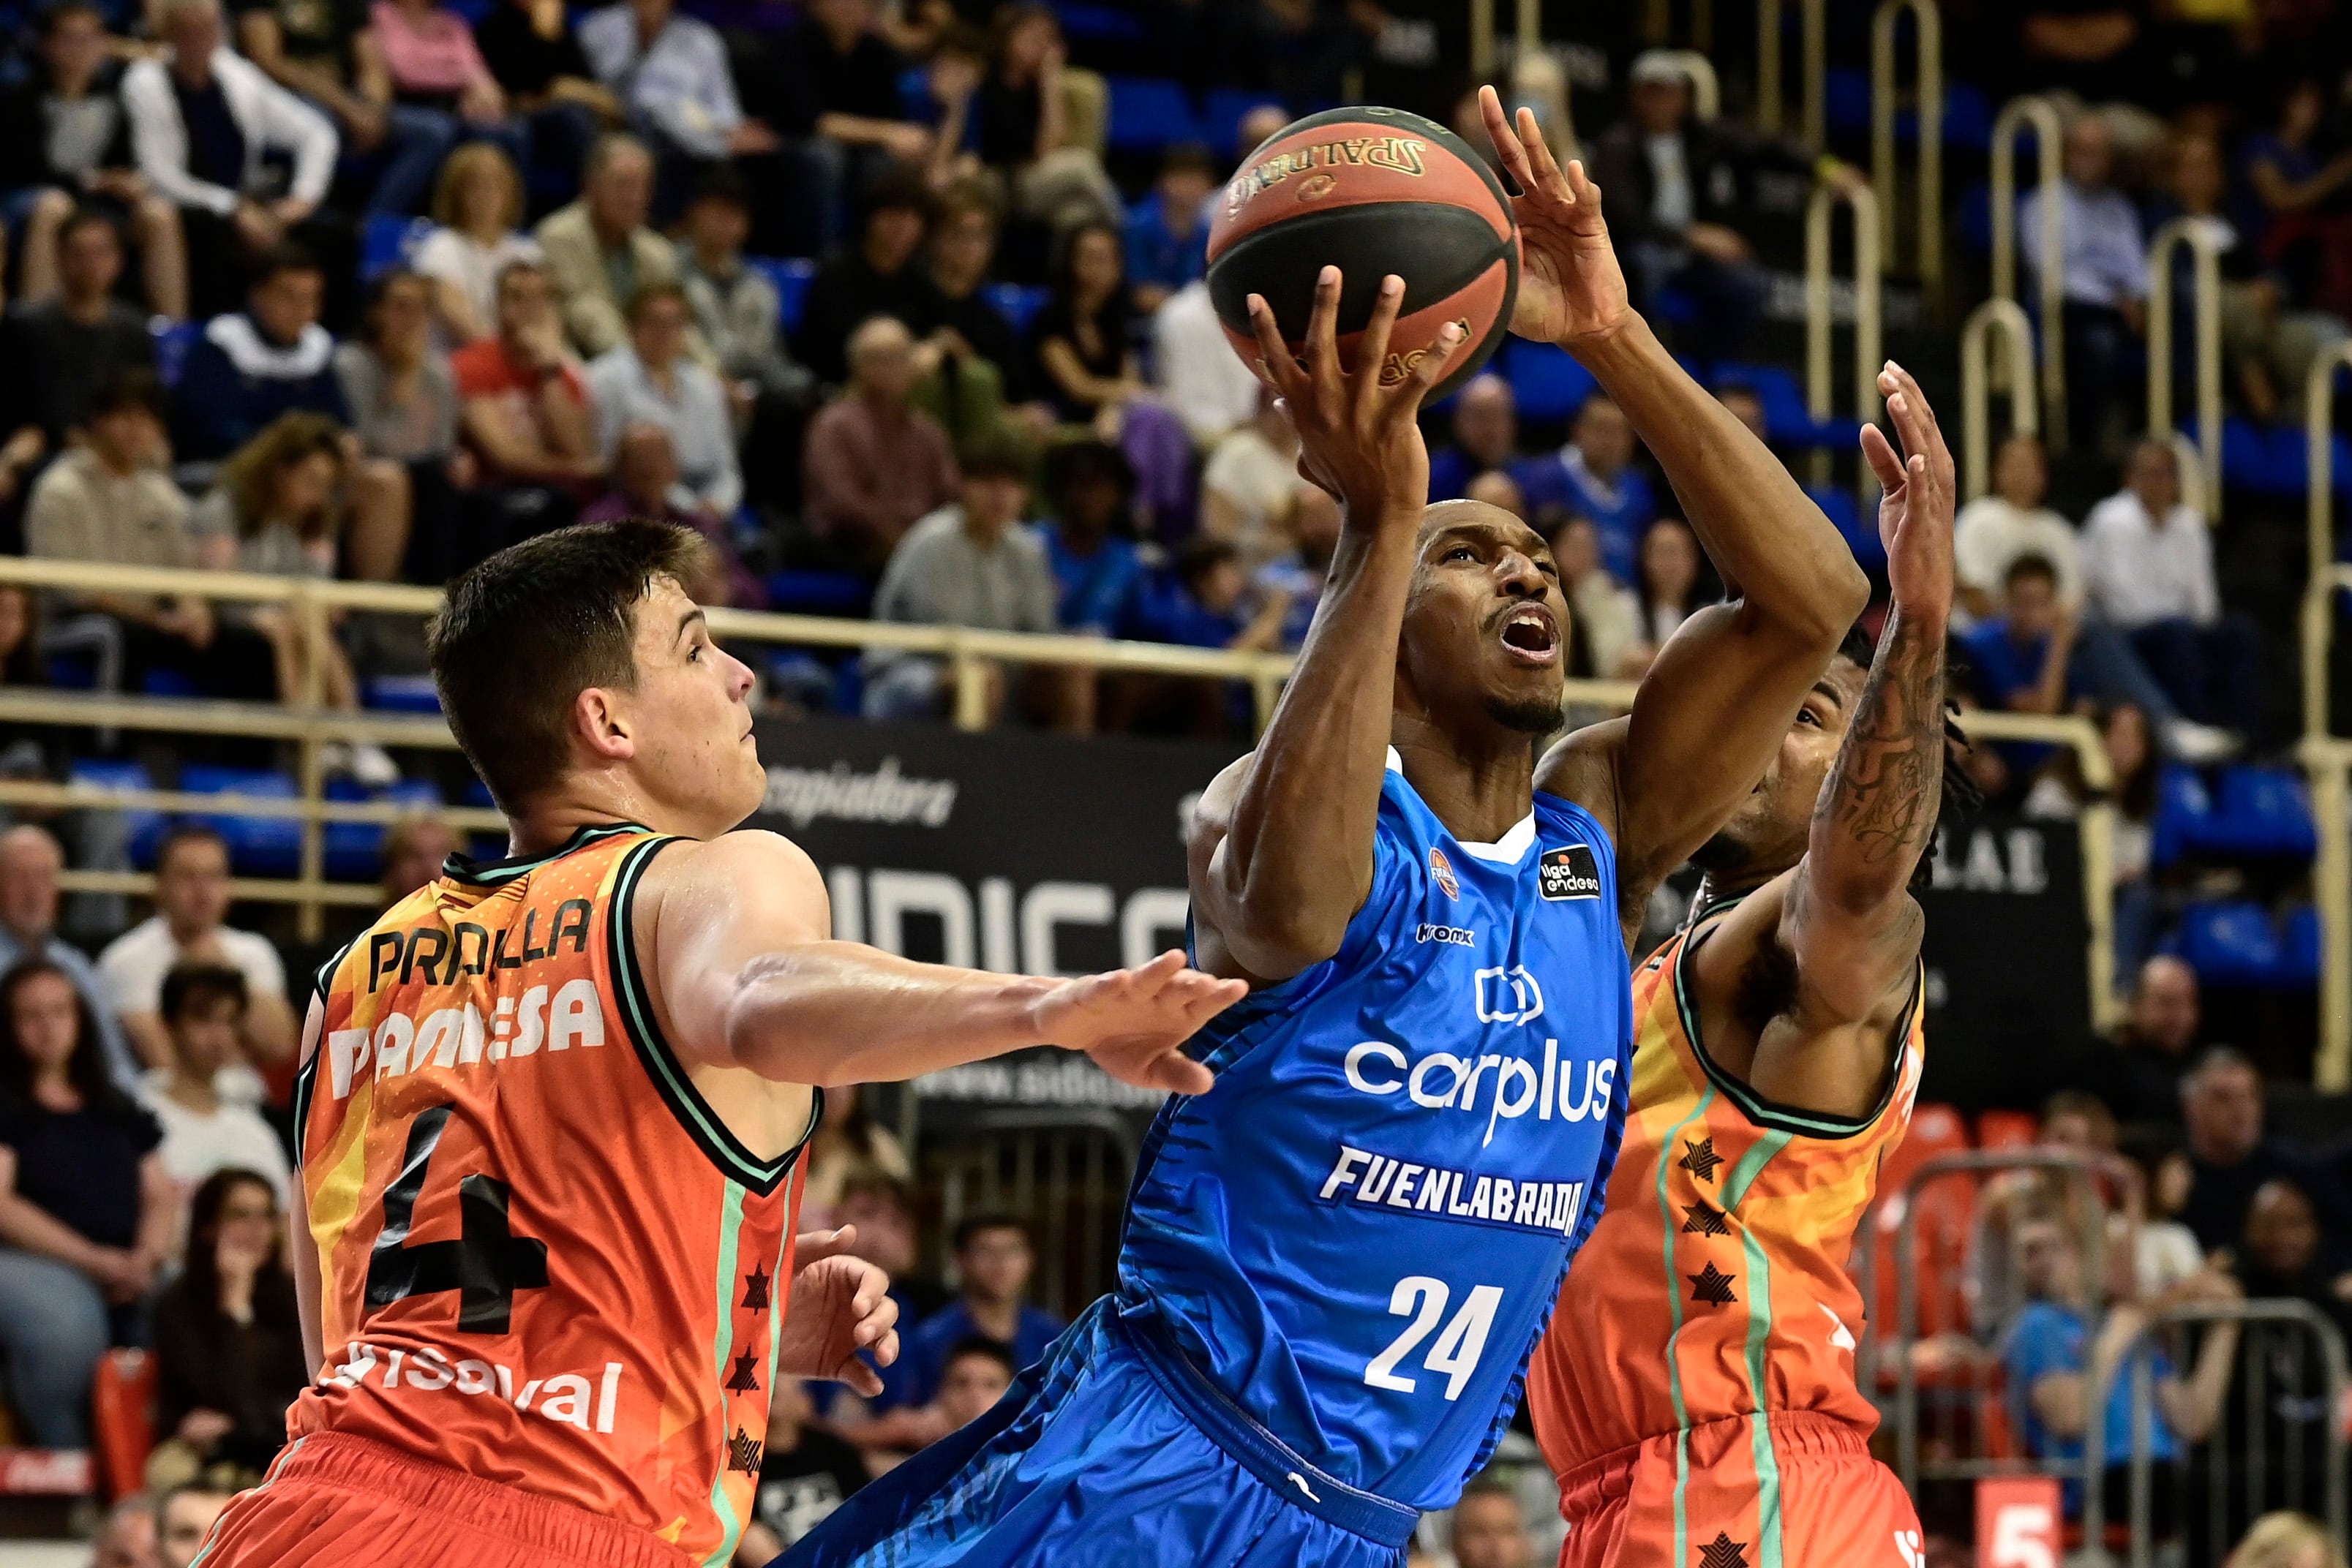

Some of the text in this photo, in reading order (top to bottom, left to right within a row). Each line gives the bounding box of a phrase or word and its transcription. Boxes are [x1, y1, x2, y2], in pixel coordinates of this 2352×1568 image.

[1541, 864, 1571, 878] liga
[328, 979, 605, 1100] PAMESA
[1345, 1039, 1616, 1147] carplus
[364, 1100, 550, 1335] 4
[1320, 1146, 1583, 1237] FUENLABRADA
[1364, 1275, 1505, 1401] 24
[1992, 1504, 2053, 1568] 5
